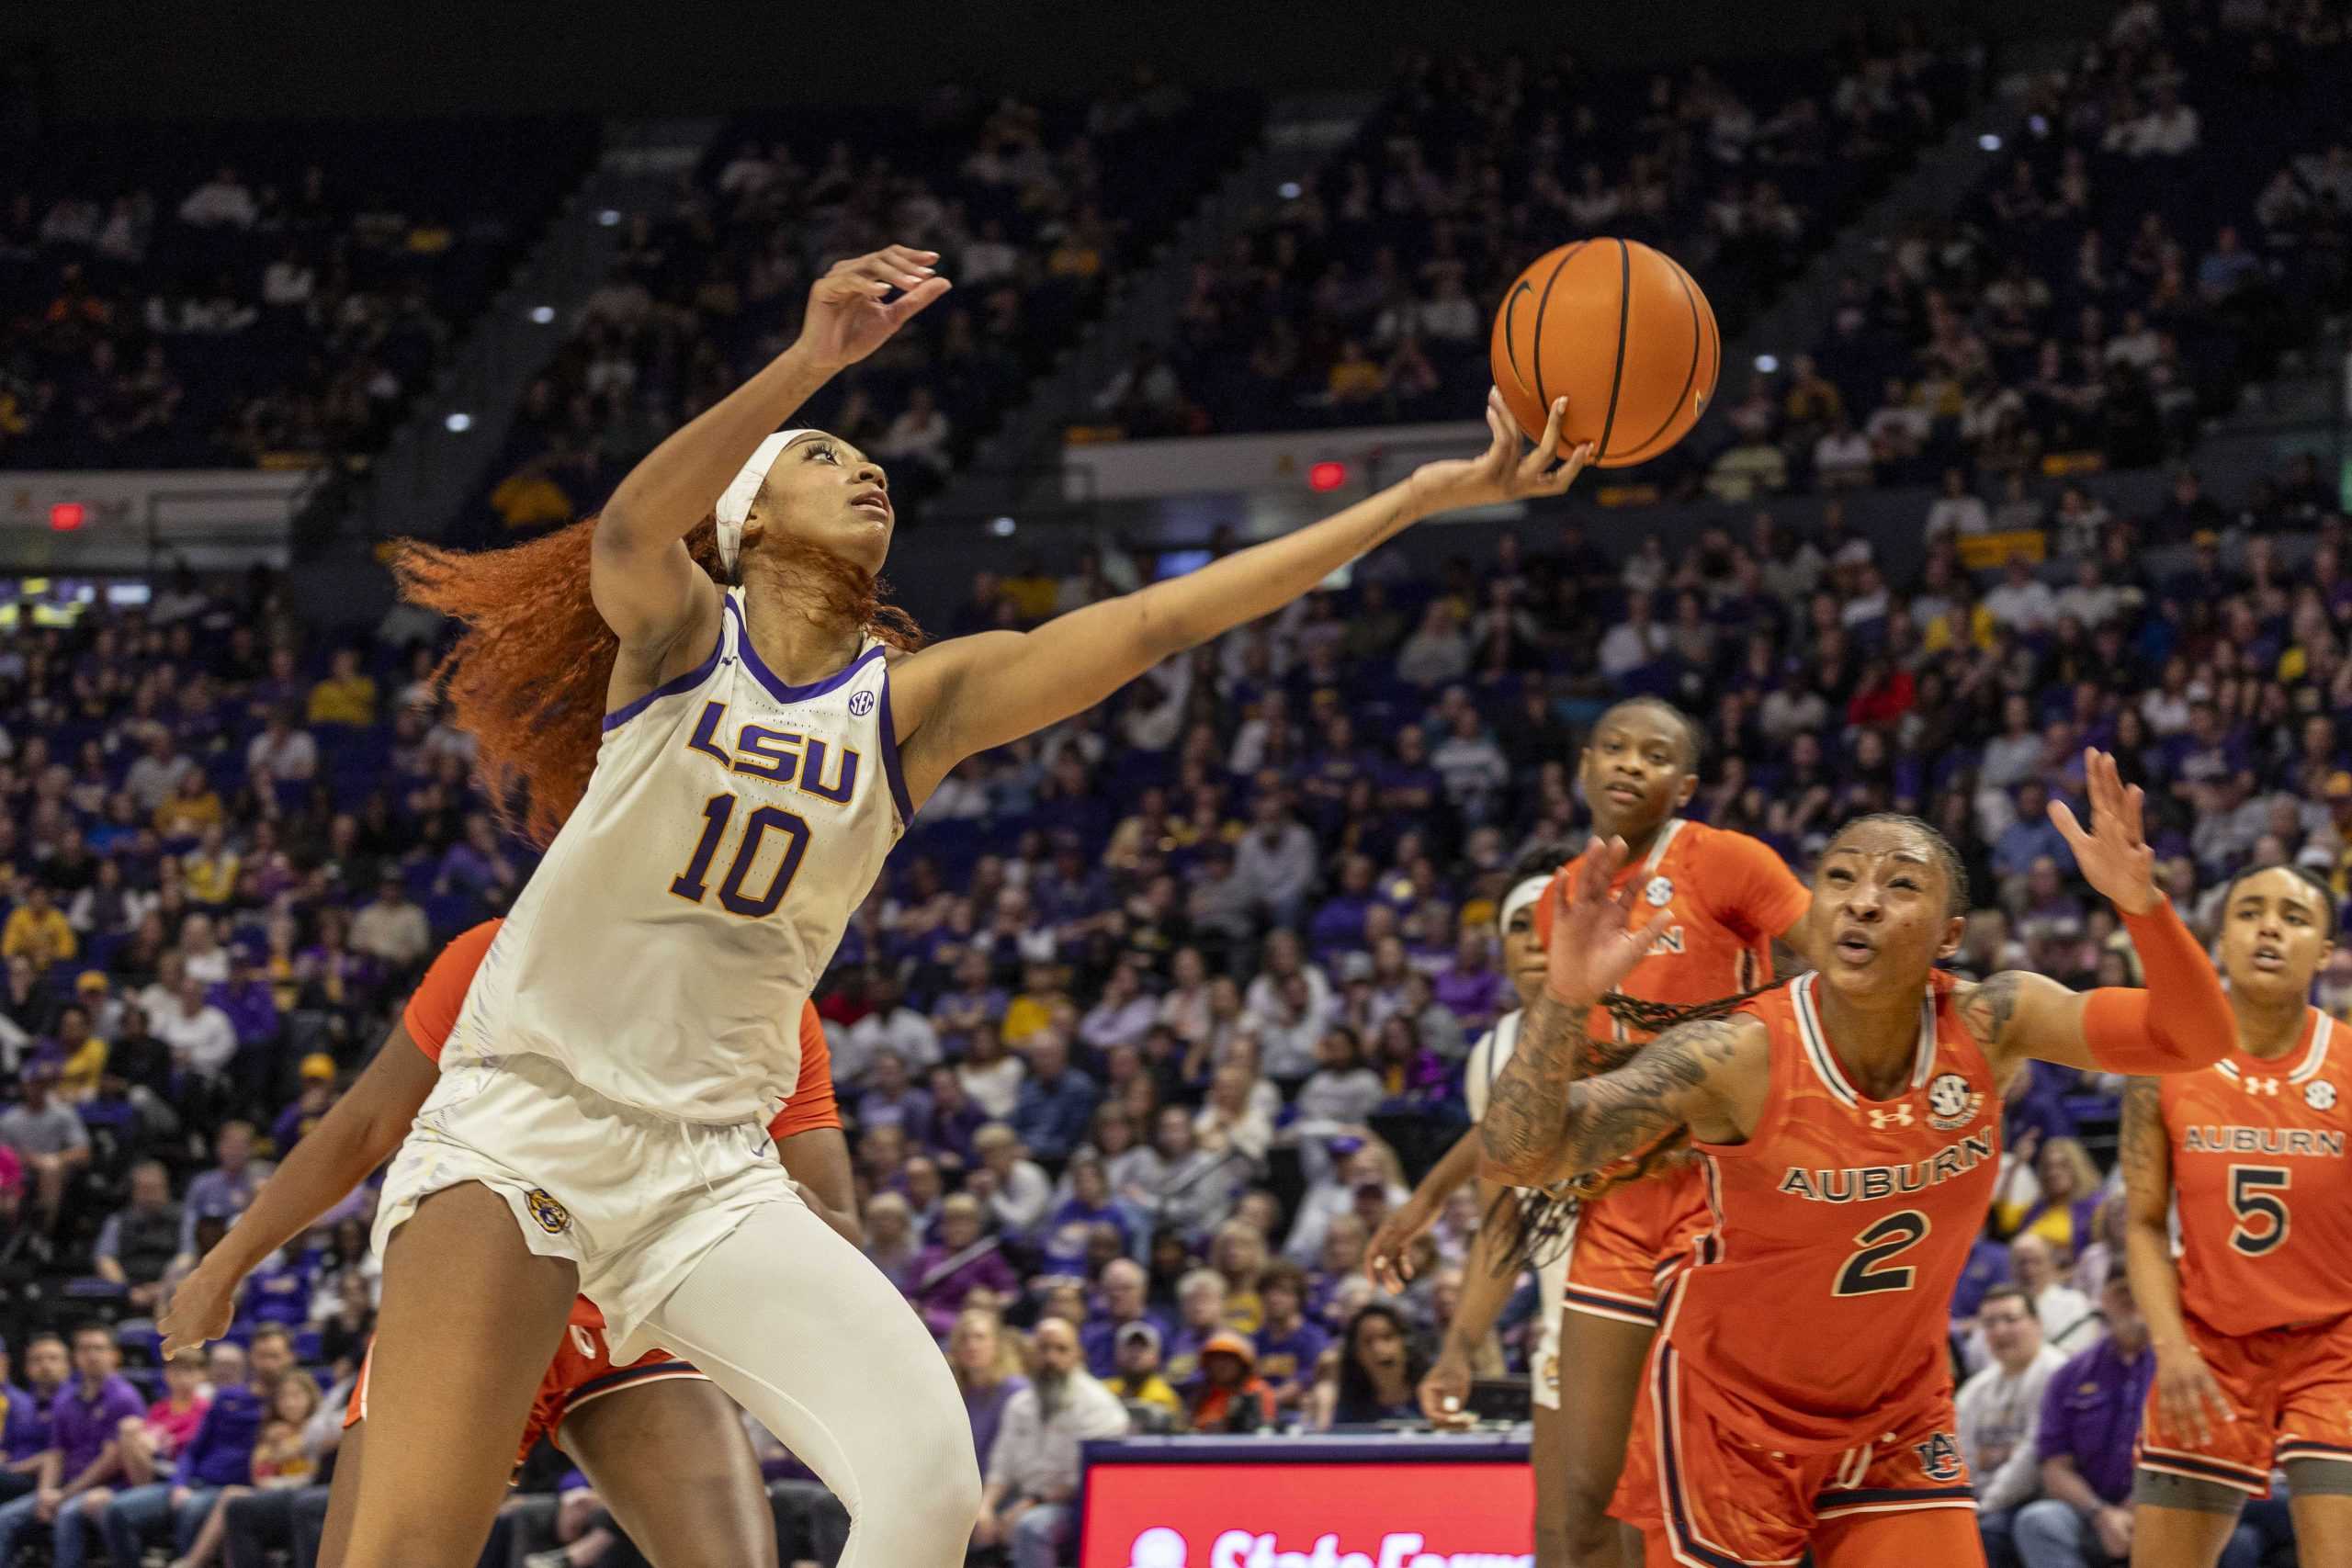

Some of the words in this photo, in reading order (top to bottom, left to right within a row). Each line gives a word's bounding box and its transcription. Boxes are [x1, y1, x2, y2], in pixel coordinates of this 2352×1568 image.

[850, 692, 874, 716] SEC
[686, 701, 860, 806] LSU
[670, 793, 811, 918] 10
[1778, 1126, 1993, 1203] AUBURN
[2183, 1124, 2346, 1157] AUBURN
[1830, 1209, 1932, 1297] 2
[2227, 1163, 2291, 1257] 5
